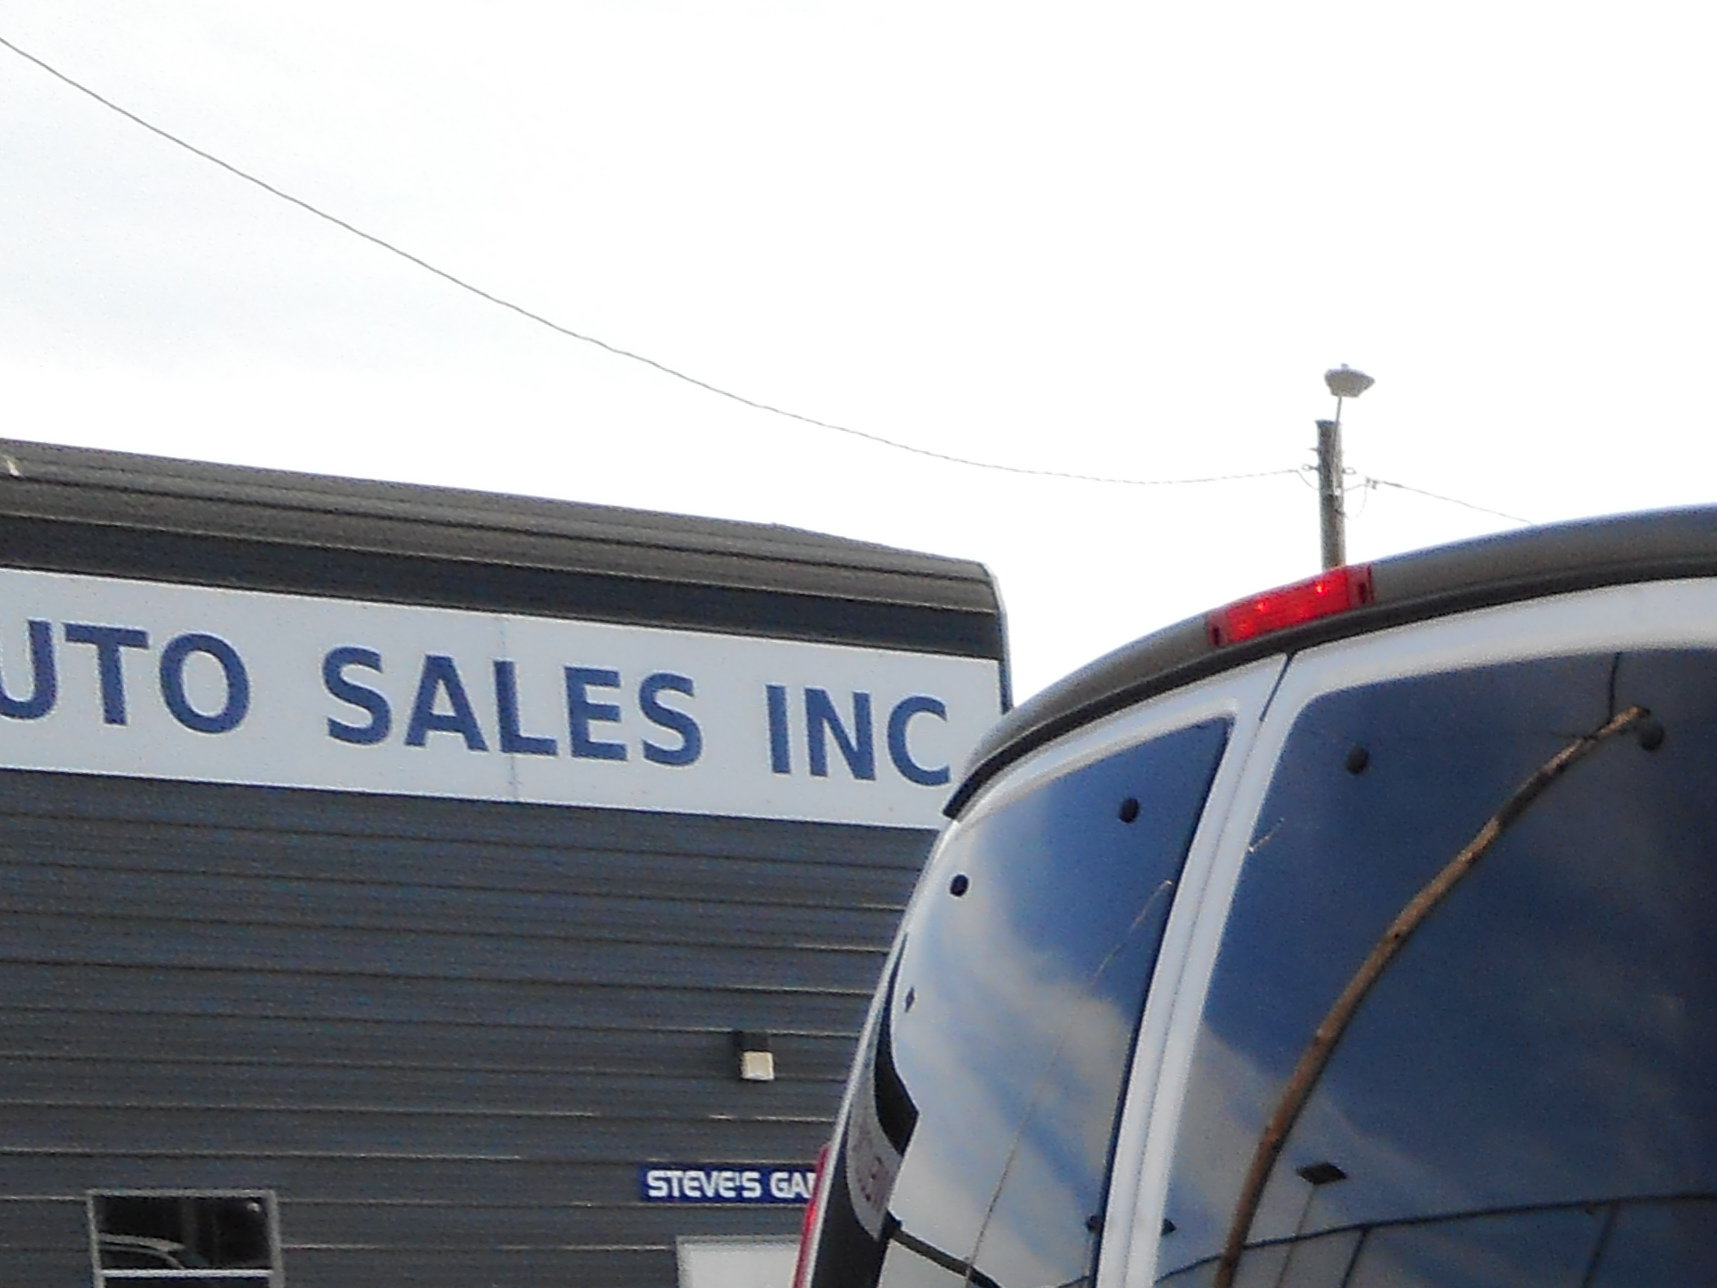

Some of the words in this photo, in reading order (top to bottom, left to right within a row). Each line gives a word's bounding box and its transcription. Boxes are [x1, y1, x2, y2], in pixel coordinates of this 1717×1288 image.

[0, 619, 250, 734] UTO
[322, 646, 703, 768] SALES
[766, 684, 951, 787] INC
[647, 1170, 762, 1198] STEVE'S
